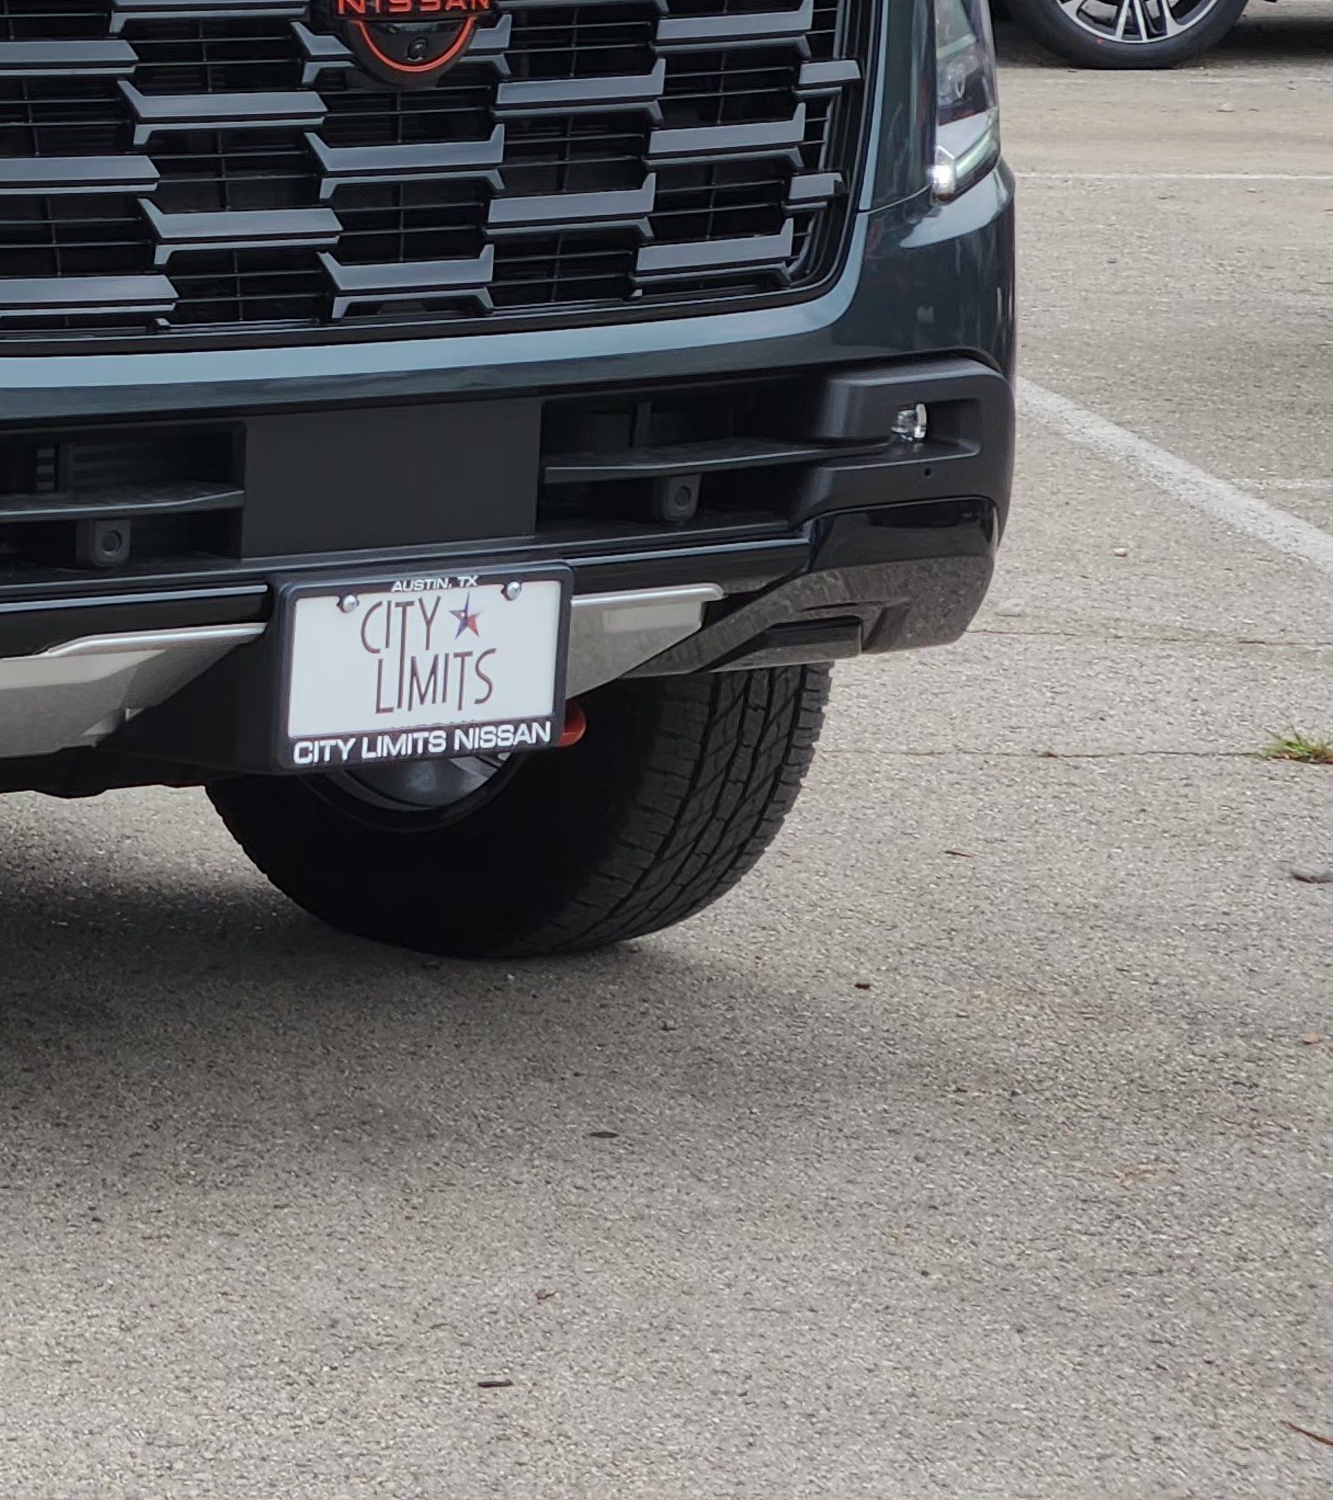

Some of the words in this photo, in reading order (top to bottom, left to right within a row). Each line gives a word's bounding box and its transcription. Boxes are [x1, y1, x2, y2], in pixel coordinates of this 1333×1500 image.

[391, 577, 452, 592] AUSTIN,
[457, 575, 478, 588] TX
[361, 596, 441, 660] CITY
[375, 648, 497, 714] LIMITS
[293, 738, 356, 765] CITY
[361, 730, 447, 760] LIMITS
[454, 721, 551, 750] NISSAN
